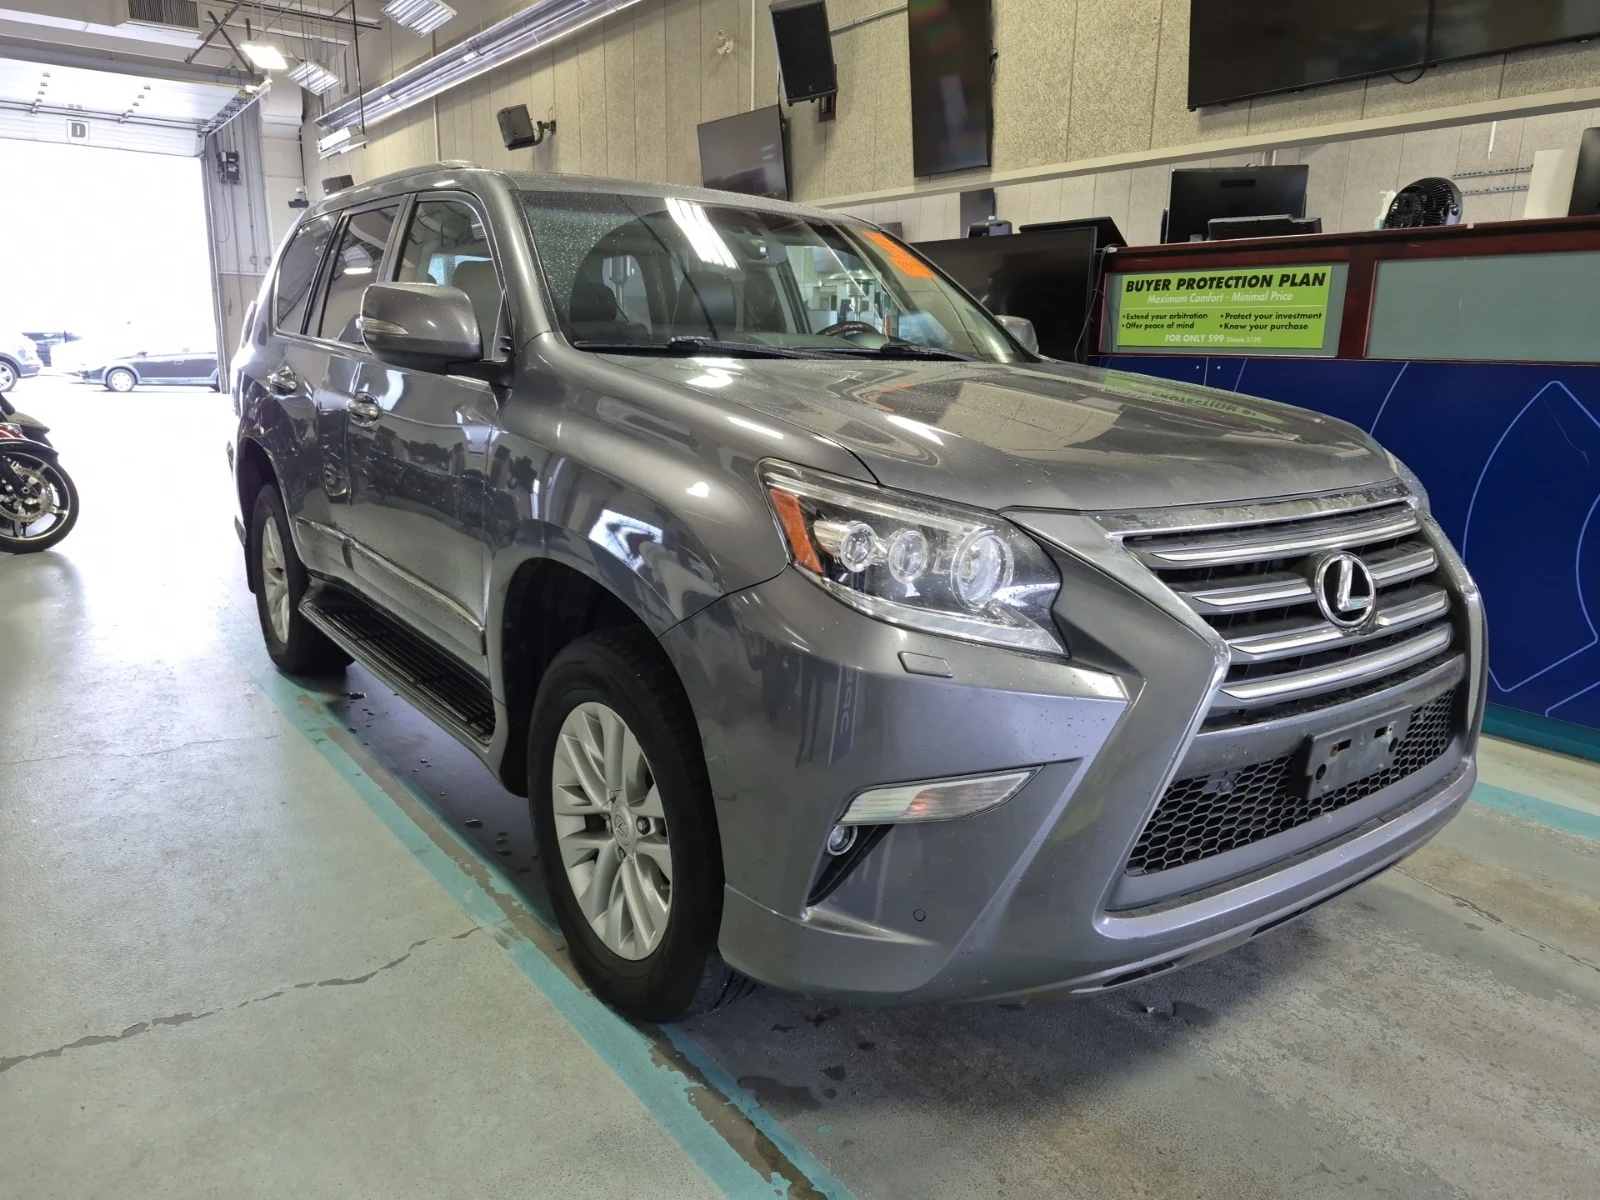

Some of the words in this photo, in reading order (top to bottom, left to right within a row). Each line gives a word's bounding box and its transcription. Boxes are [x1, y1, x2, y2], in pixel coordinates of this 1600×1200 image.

[72, 122, 86, 138] D
[1126, 279, 1172, 292] BUYER
[1176, 274, 1274, 291] PROTECTION
[1278, 272, 1327, 287] PLAN
[1147, 293, 1187, 304] Maximum
[1189, 292, 1224, 303] Comfort
[1231, 290, 1269, 302] Minimal
[1270, 290, 1293, 301] Price
[1126, 312, 1149, 320] Extend
[1150, 313, 1167, 321] your
[1224, 312, 1252, 320] Protect
[1254, 313, 1273, 321] your
[1275, 312, 1322, 320] investment
[1176, 321, 1195, 329] mind
[1223, 322, 1247, 330] Know
[1249, 323, 1268, 331] your
[1270, 321, 1308, 331] purchase
[1164, 334, 1181, 342] FOR
[1182, 334, 1206, 342] ONLY
[1208, 334, 1225, 343] $99
